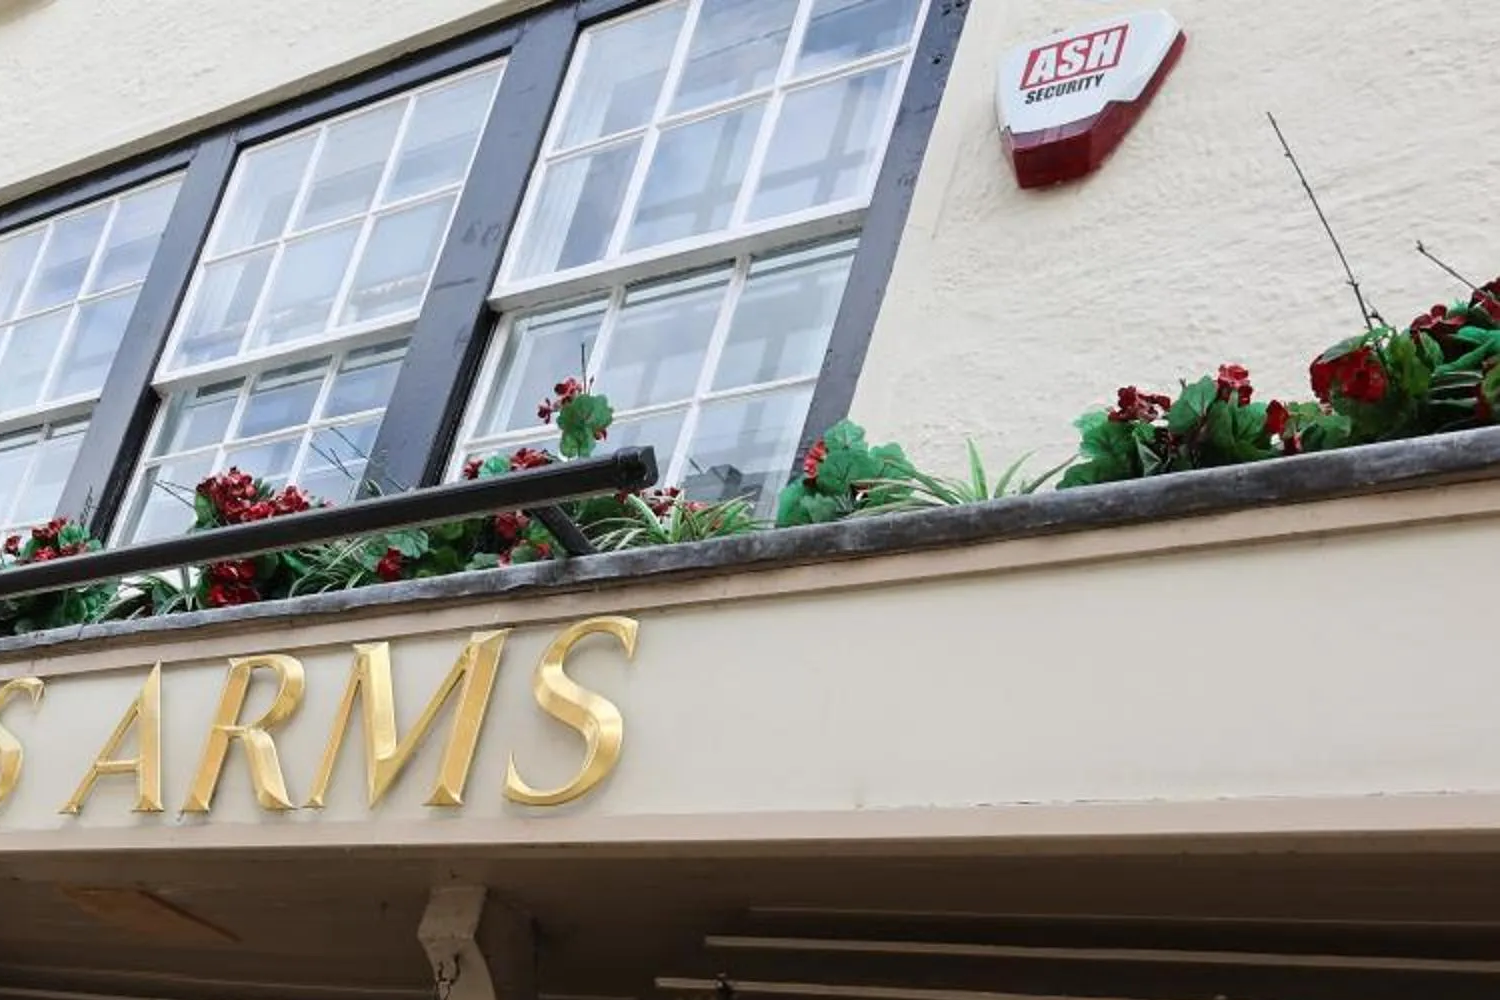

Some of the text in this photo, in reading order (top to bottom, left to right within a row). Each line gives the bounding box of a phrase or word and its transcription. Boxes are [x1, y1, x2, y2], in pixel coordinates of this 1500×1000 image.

[1024, 29, 1124, 86] ASH
[1025, 73, 1105, 105] SECURITY
[59, 615, 638, 815] ARMS
